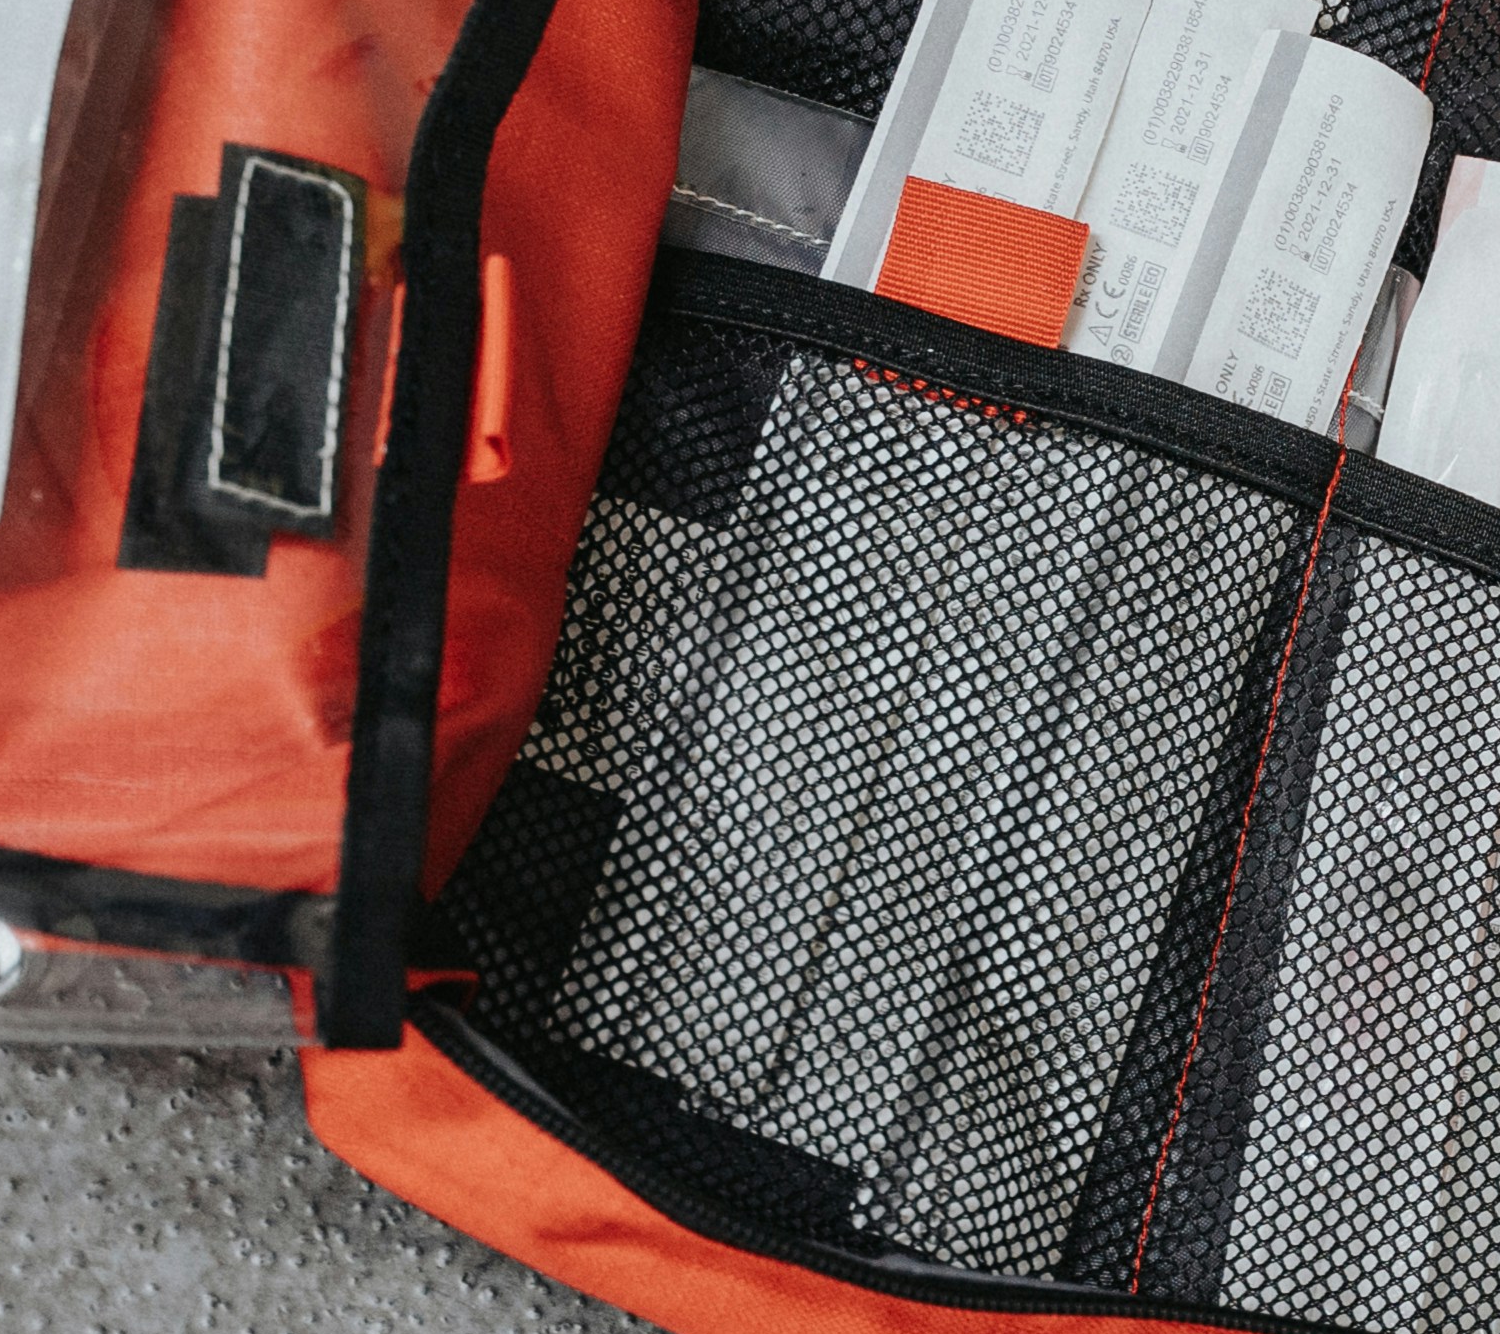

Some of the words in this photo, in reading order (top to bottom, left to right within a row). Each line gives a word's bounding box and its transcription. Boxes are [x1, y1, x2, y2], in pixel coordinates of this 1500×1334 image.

[1043, 0, 1078, 66] 9024534
[1054, 145, 1078, 181] Street,
[1067, 108, 1091, 142] Sandy,
[1083, 76, 1100, 104] Utah
[1092, 41, 1113, 76] 84070
[1169, 51, 1213, 136] 2021-12-31
[1198, 74, 1233, 139] 9024534
[1274, 94, 1344, 257] (01)00382903818549
[1297, 157, 1342, 243] 2021-12-31
[1321, 182, 1358, 248] 9024534
[1081, 239, 1107, 286] ONLY
[1118, 254, 1138, 287] 0086
[1072, 288, 1091, 309] Rx
[1119, 289, 1154, 344] STERILE
[1142, 265, 1165, 286] EO
[1316, 366, 1334, 396] State
[1327, 330, 1349, 365] Street,
[1341, 291, 1364, 326] Sandy,
[1356, 260, 1374, 288] Utah
[1367, 223, 1387, 259] 84070
[1215, 349, 1239, 393] ONLY
[1246, 364, 1265, 396] 0086
